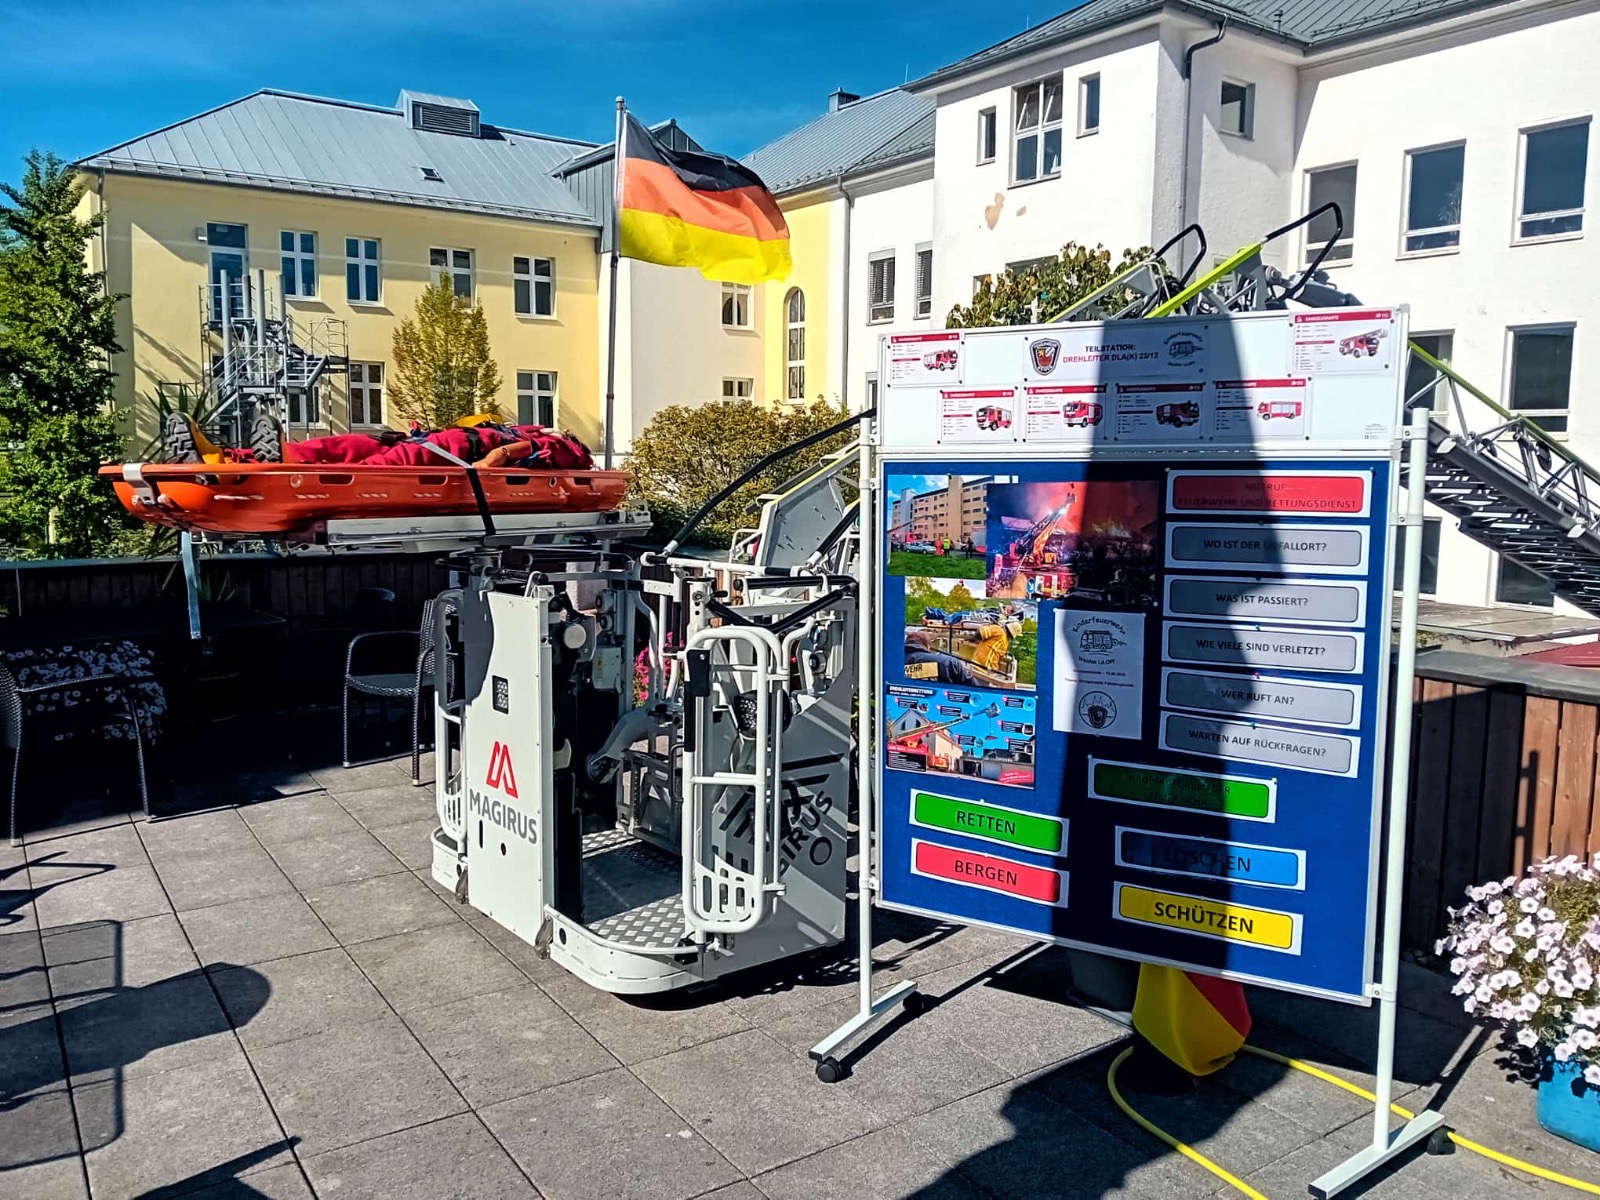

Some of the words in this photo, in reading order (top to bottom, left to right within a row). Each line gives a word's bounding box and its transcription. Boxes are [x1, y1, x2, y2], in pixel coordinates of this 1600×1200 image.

[1085, 344, 1137, 353] TEILSTATION:
[1063, 354, 1109, 363] DREHLEITER
[1203, 539, 1222, 549] WO
[1224, 540, 1238, 549] IST
[1241, 540, 1260, 550] DER
[1264, 542, 1327, 552] FALLORT?
[1216, 594, 1238, 603] WAS
[1241, 594, 1255, 604] IST
[1258, 595, 1309, 607] PASSIERT?
[1196, 639, 1215, 649] WIE
[1217, 640, 1243, 651] VIELE
[1246, 642, 1270, 652] SIND
[1272, 644, 1326, 656] VERLETZT?
[1221, 689, 1244, 700] WER
[1246, 692, 1272, 703] RUFT
[1274, 695, 1295, 706] AN?
[1188, 729, 1229, 744] WARTEN
[1232, 736, 1251, 747] AUF
[1254, 737, 1327, 757] RÜCKFRAGEN?
[470, 788, 537, 845] MAGIRUS
[956, 810, 1016, 836] RETTEN
[955, 859, 1018, 886] BERGEN
[1155, 901, 1254, 935] SCHÜTZEN
